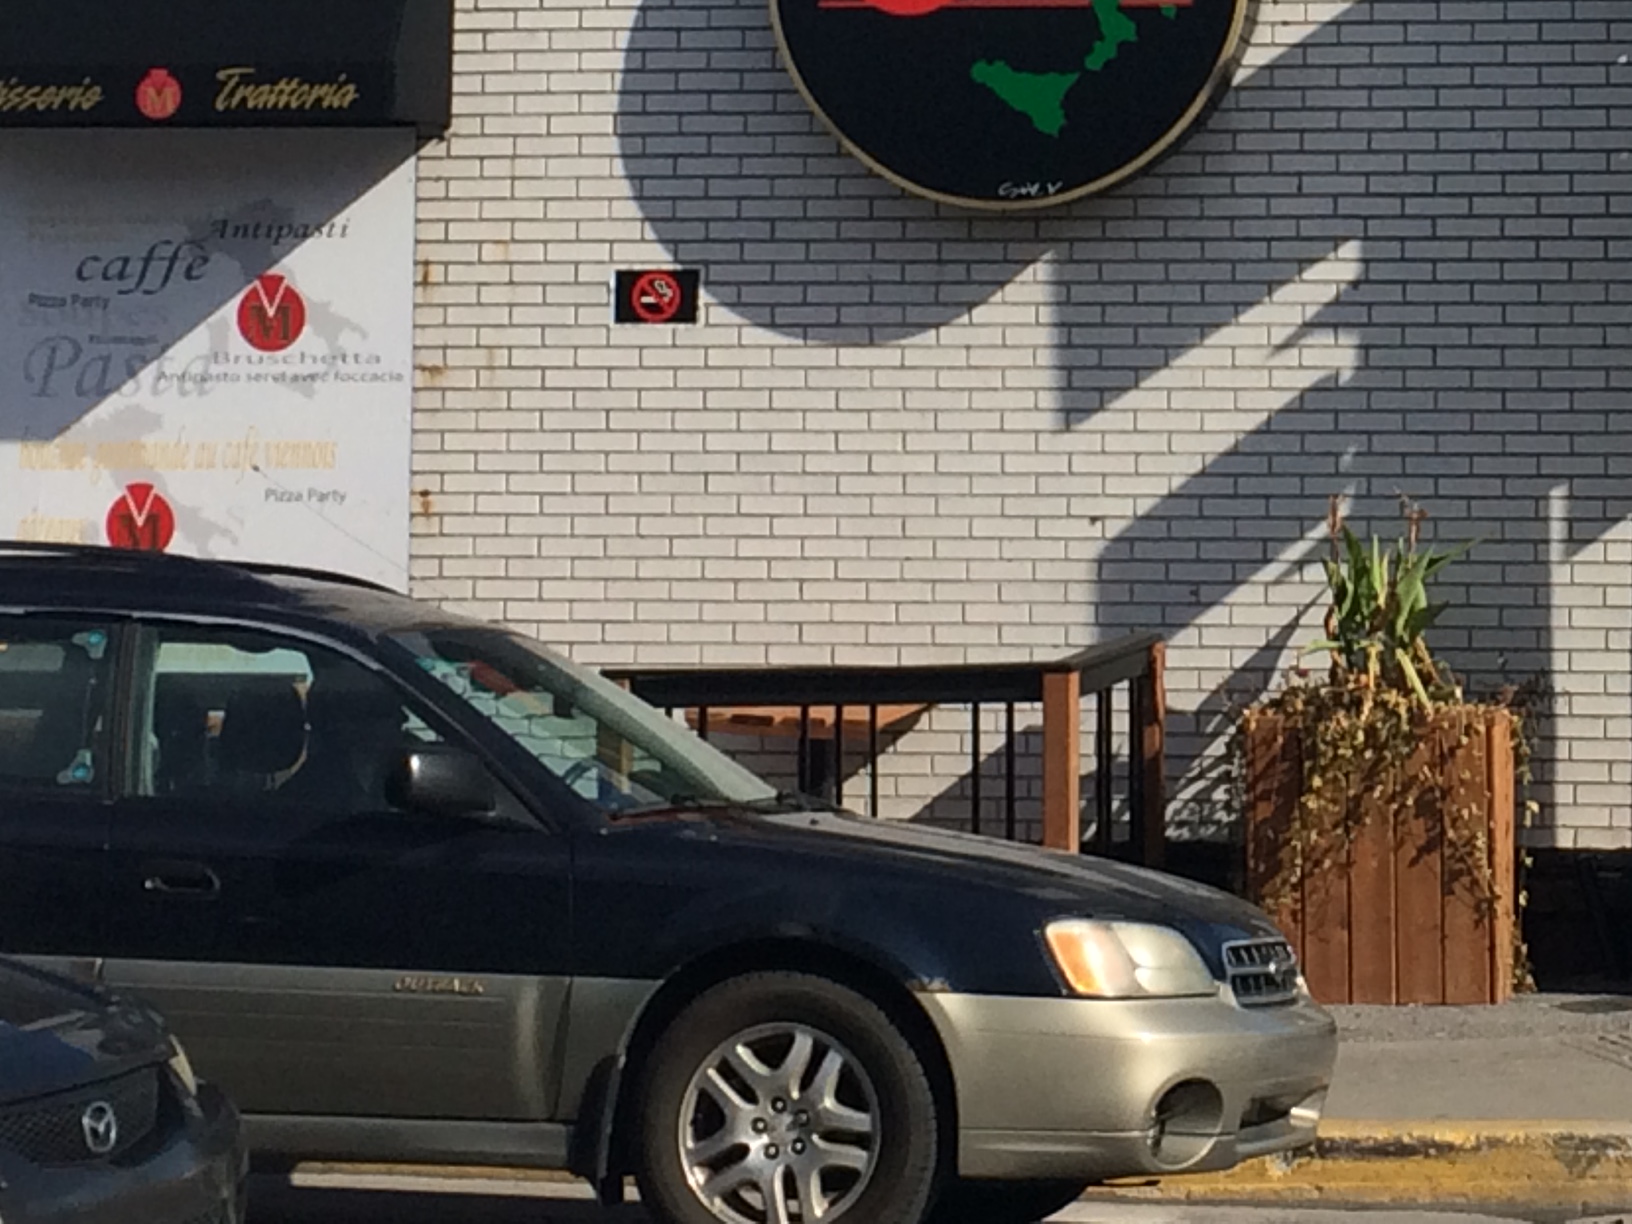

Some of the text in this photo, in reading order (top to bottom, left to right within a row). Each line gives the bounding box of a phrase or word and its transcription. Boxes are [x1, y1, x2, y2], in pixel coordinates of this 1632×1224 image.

[213, 67, 359, 112] Trattoria
[209, 219, 353, 242] Antipasti
[22, 334, 215, 398] Pasta
[212, 351, 382, 365] Bruschetta
[264, 487, 347, 506] Pizza Party
